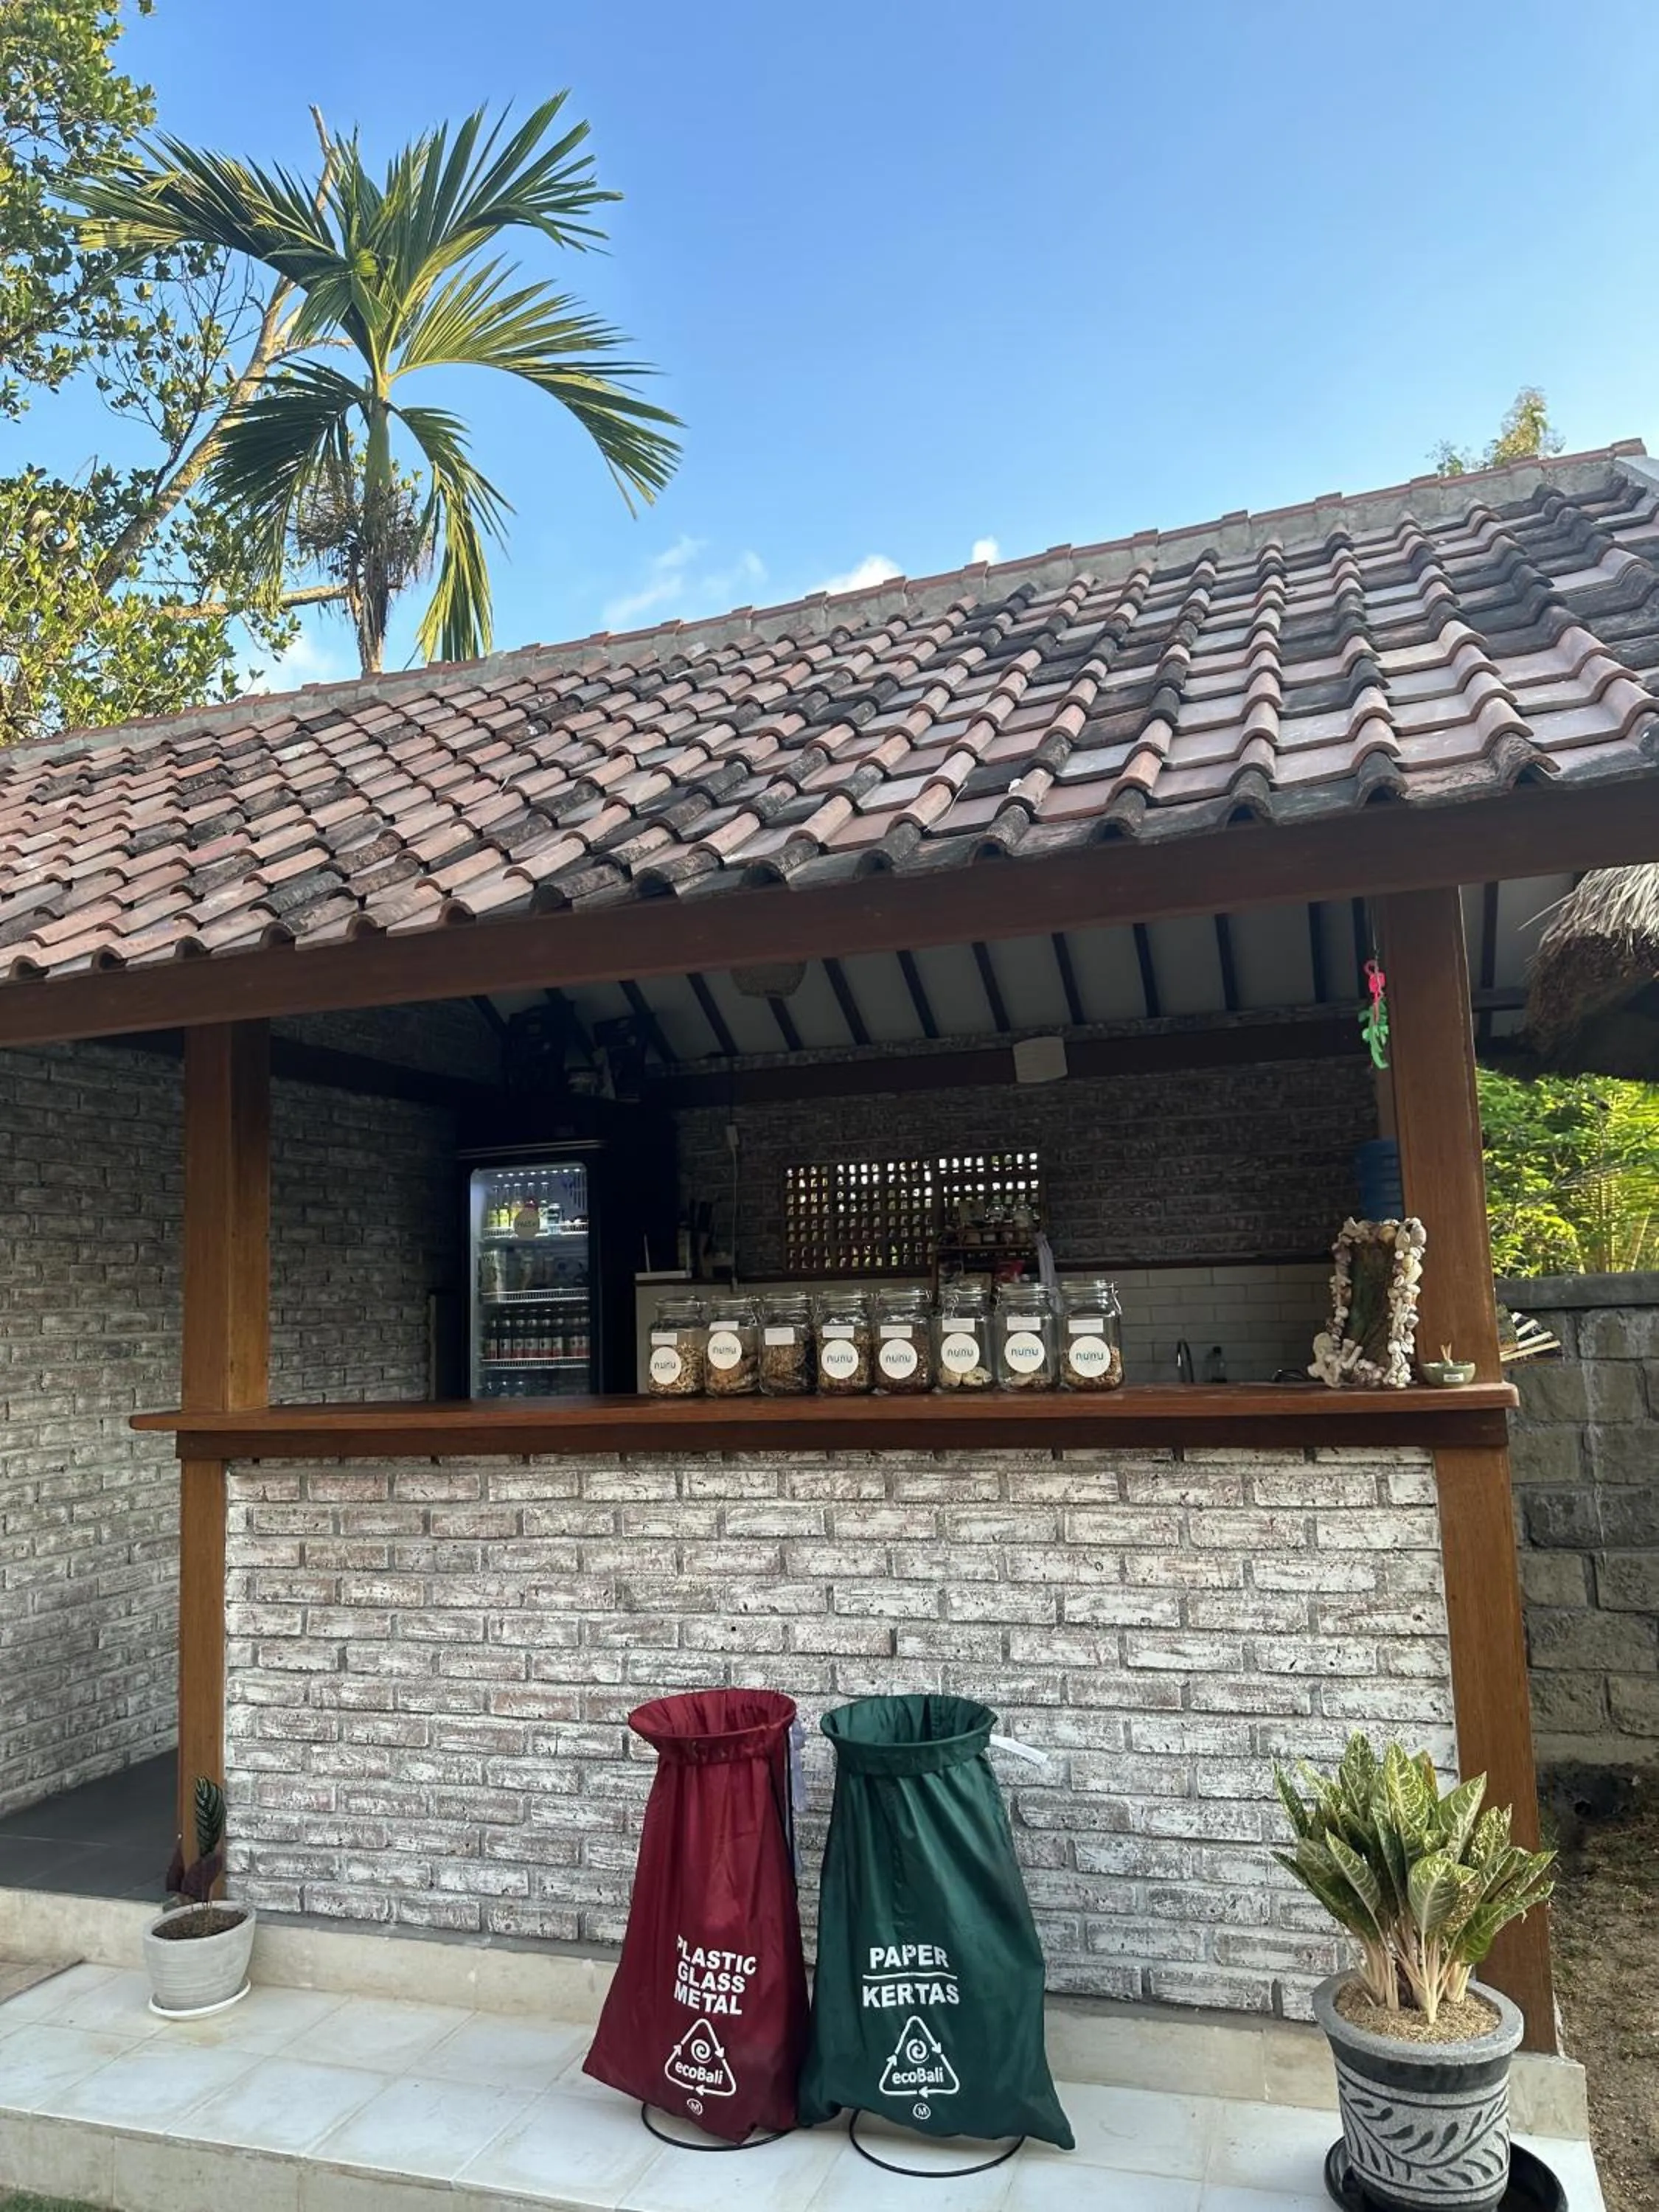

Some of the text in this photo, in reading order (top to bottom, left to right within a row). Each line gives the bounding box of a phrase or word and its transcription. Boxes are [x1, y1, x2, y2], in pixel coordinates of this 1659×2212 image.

[869, 1944, 950, 1969] PAPER
[677, 1962, 745, 1994] GLASS
[673, 1980, 742, 2015] METAL
[862, 1983, 960, 2008] KERTAS
[674, 2061, 723, 2085] ecoBali
[891, 2067, 944, 2084] ecoBali
